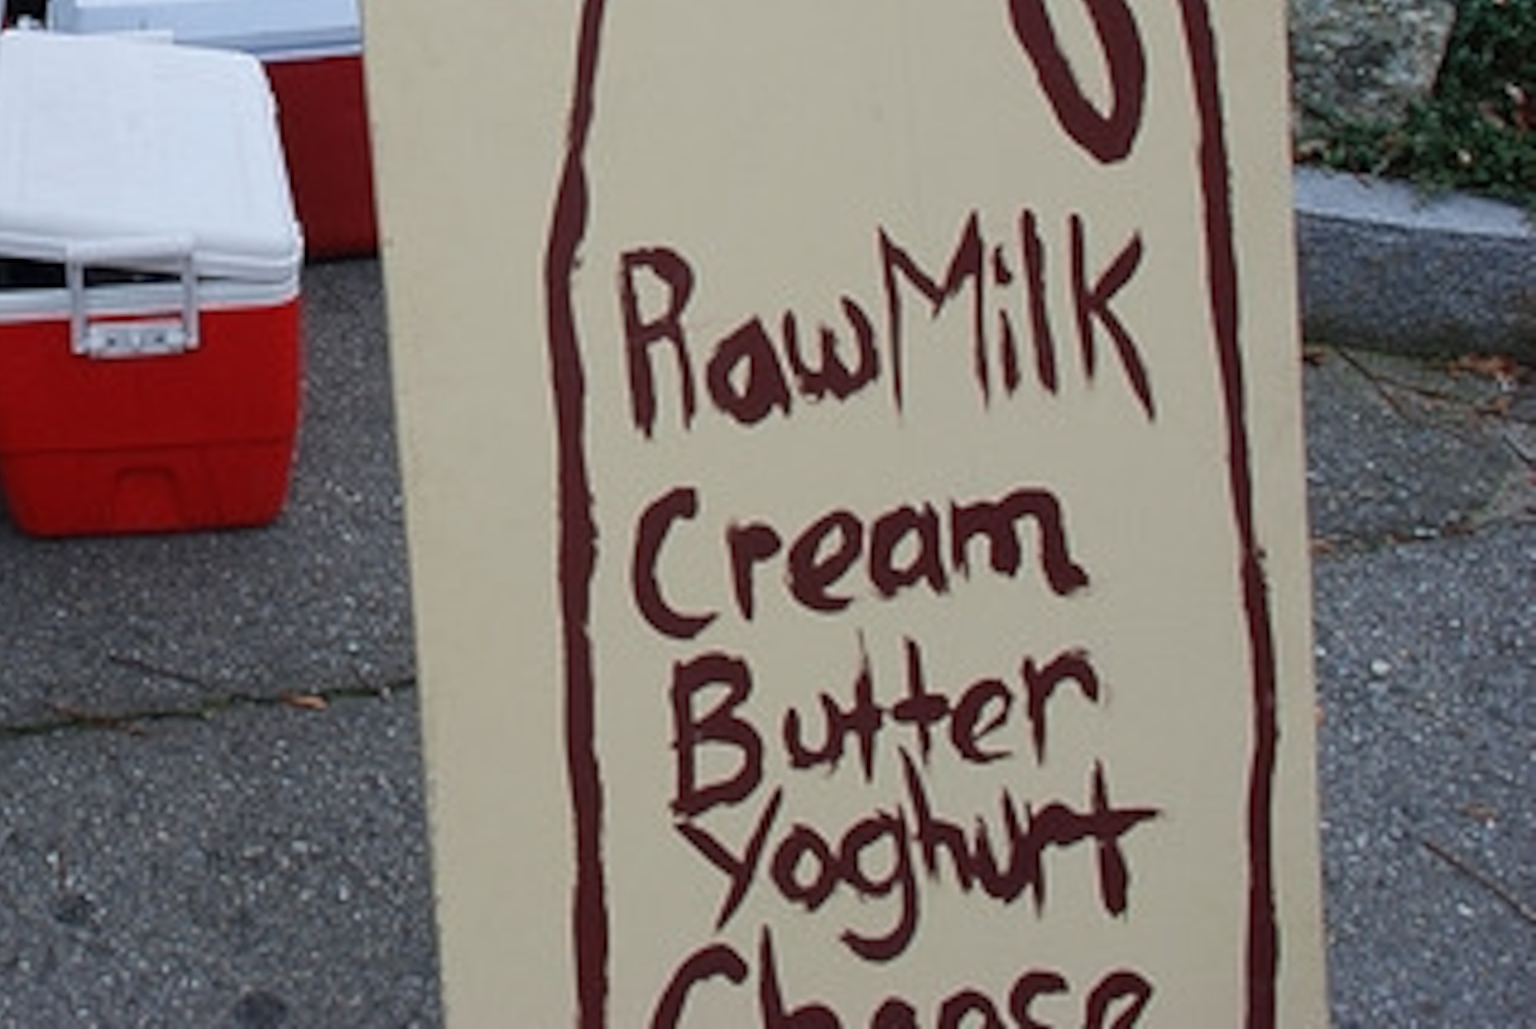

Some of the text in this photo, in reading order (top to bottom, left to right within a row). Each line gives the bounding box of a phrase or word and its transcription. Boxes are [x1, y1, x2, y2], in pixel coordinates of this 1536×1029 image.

[619, 208, 1157, 441] Raw Milk
[630, 486, 1091, 640] Cream
[669, 630, 1104, 818] Butter
[674, 745, 1163, 962] Yoghurt
